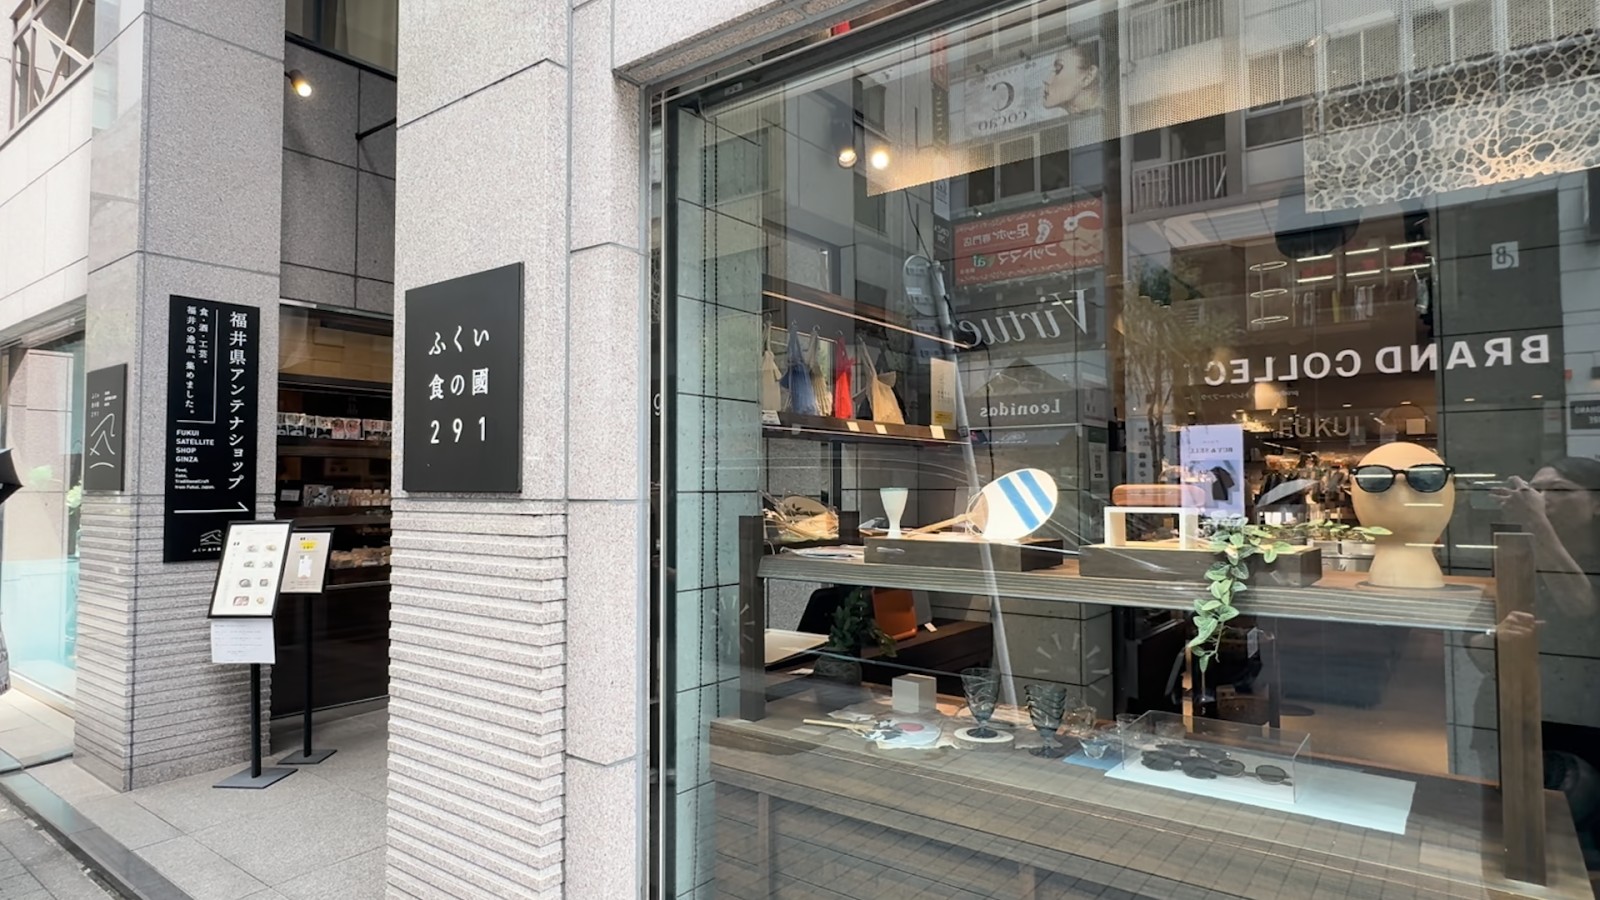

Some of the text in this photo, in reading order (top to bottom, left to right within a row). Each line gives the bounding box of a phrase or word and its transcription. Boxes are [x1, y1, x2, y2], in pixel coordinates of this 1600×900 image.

[428, 325, 490, 356] ふくい
[428, 367, 490, 401] 食の國
[228, 311, 248, 490] 福井県アンテナショップ
[430, 416, 487, 445] 291
[1279, 415, 1360, 438] FUKUI
[175, 438, 215, 446] SATELLITE
